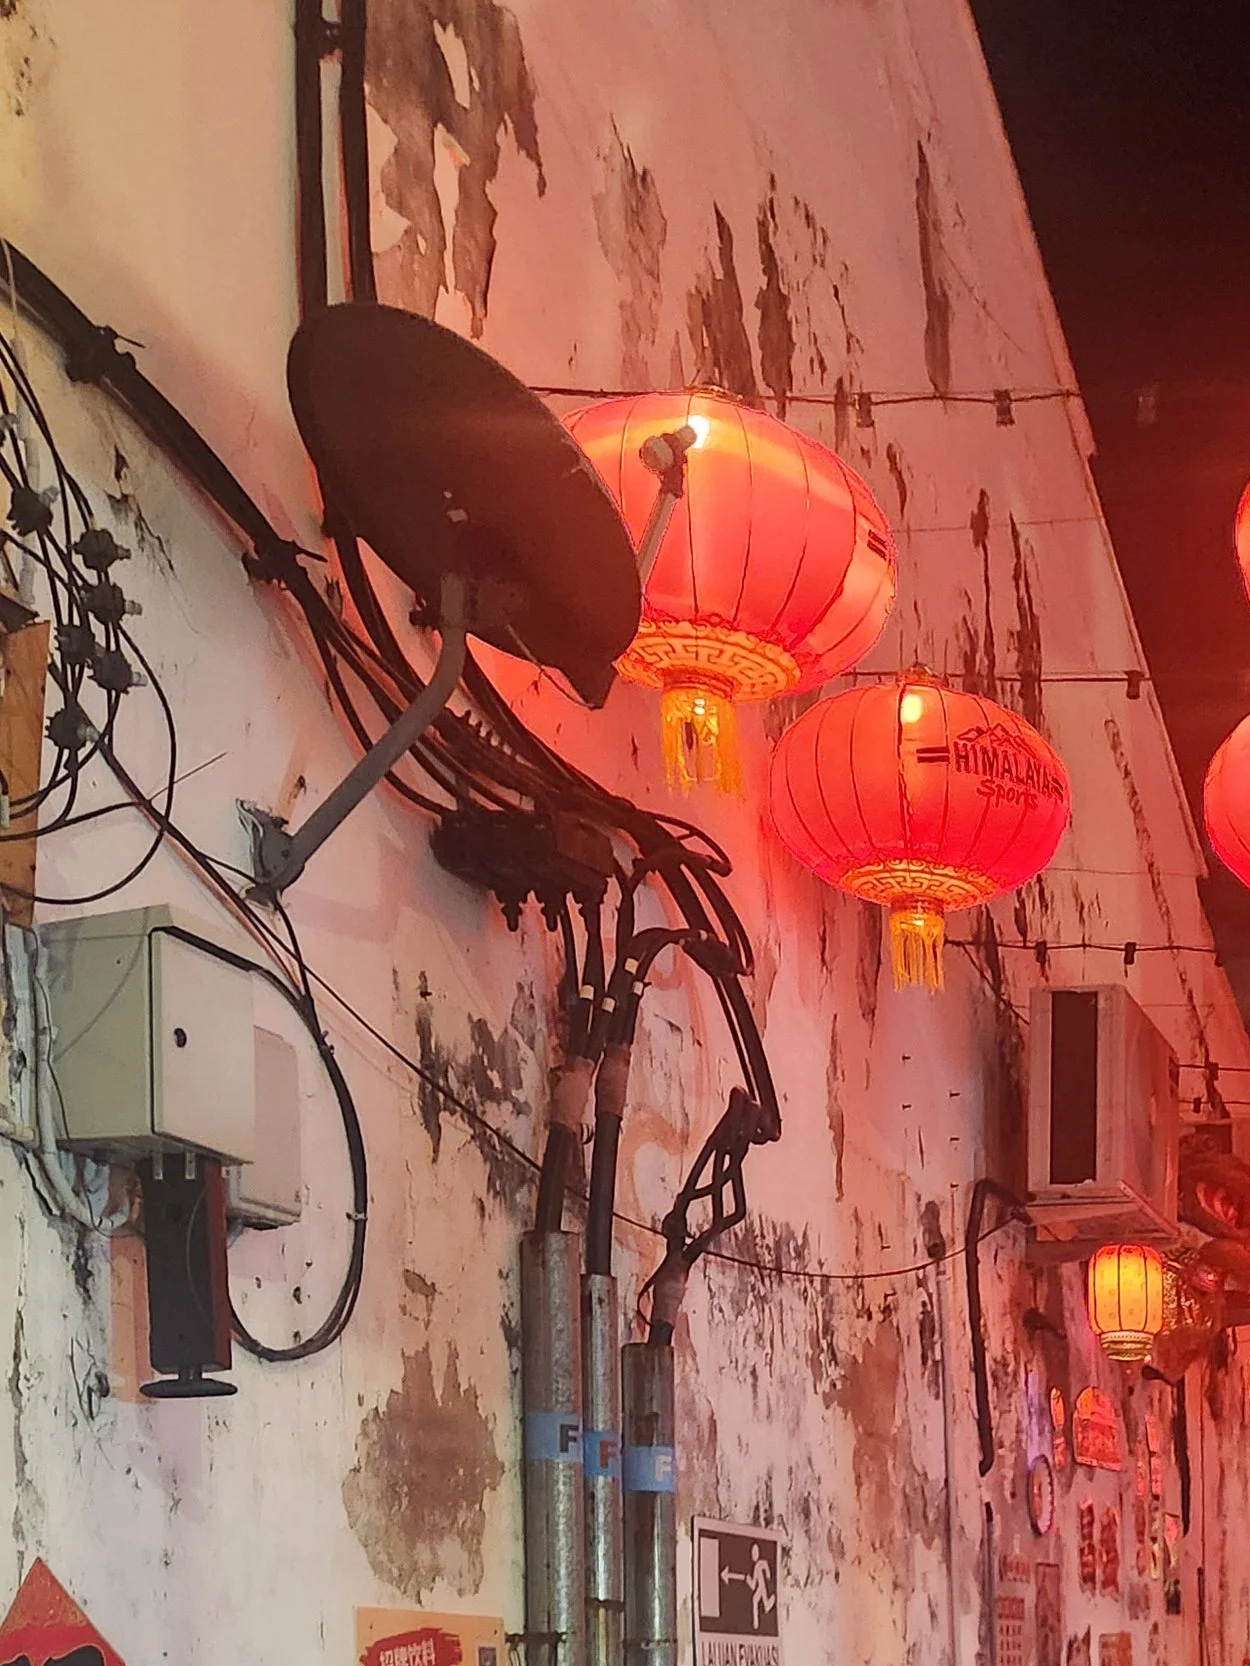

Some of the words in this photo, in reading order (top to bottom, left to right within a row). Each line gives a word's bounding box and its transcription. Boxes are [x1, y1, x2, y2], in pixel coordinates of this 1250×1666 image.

[953, 740, 1052, 799] HIMALAYA
[559, 1423, 579, 1454] F
[654, 1454, 673, 1482] F
